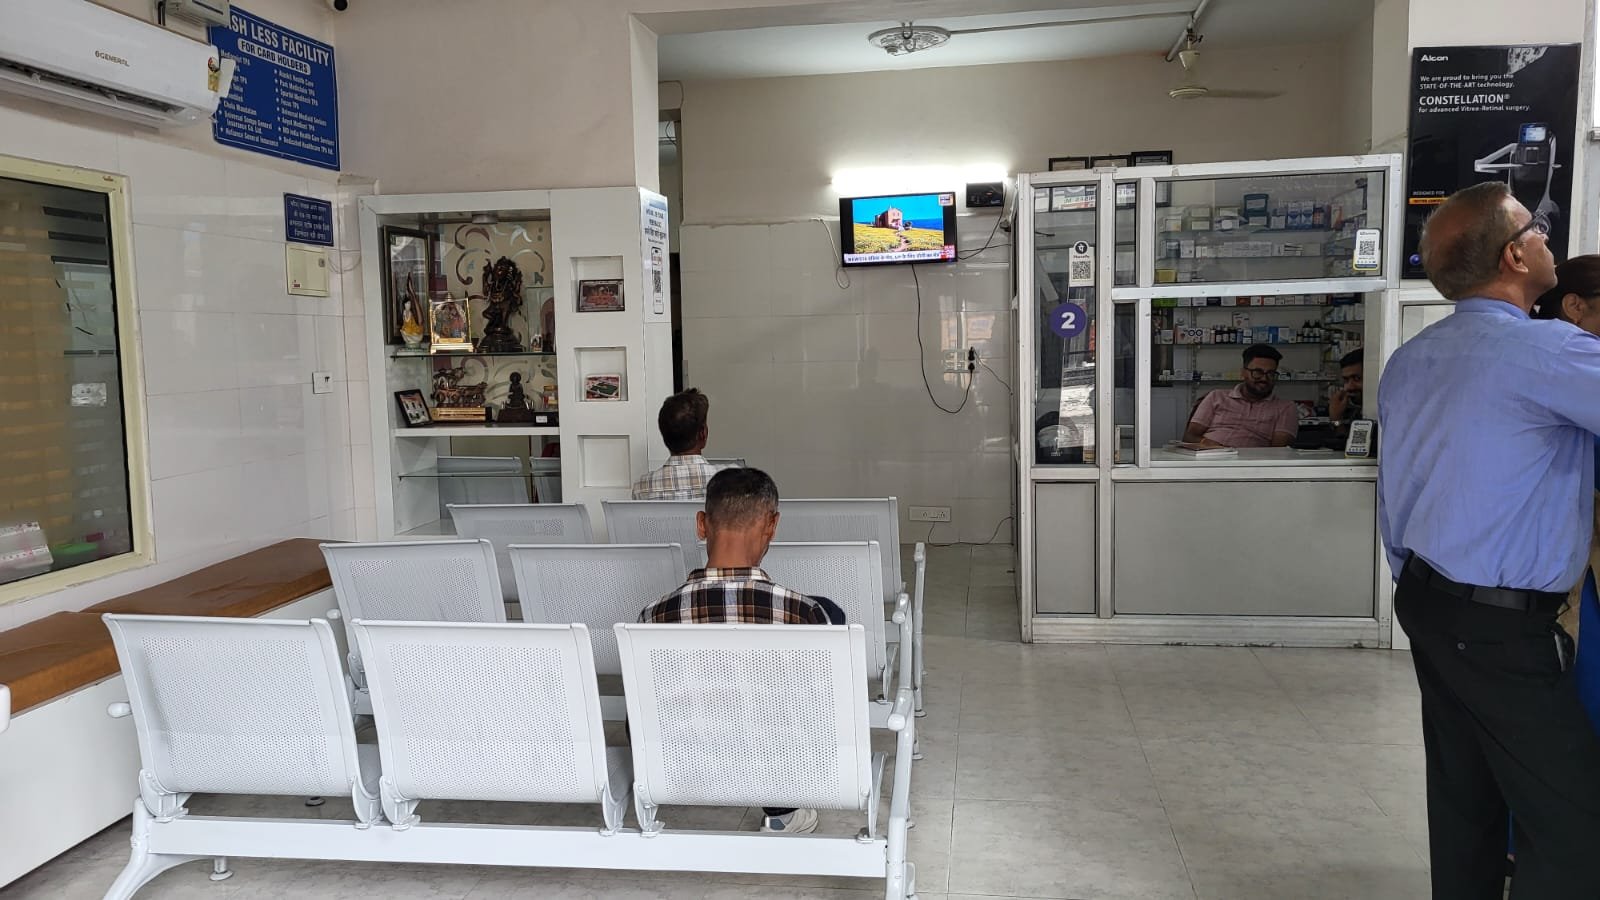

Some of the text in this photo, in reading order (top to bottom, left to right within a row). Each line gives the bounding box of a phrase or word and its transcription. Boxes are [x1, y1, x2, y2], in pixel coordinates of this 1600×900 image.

[251, 22, 279, 48] LESS
[282, 36, 329, 66] FACILITY
[241, 41, 308, 73] FOR CARD HOLDERS
[1420, 54, 1449, 62] Alcon
[1061, 312, 1075, 329] 2
